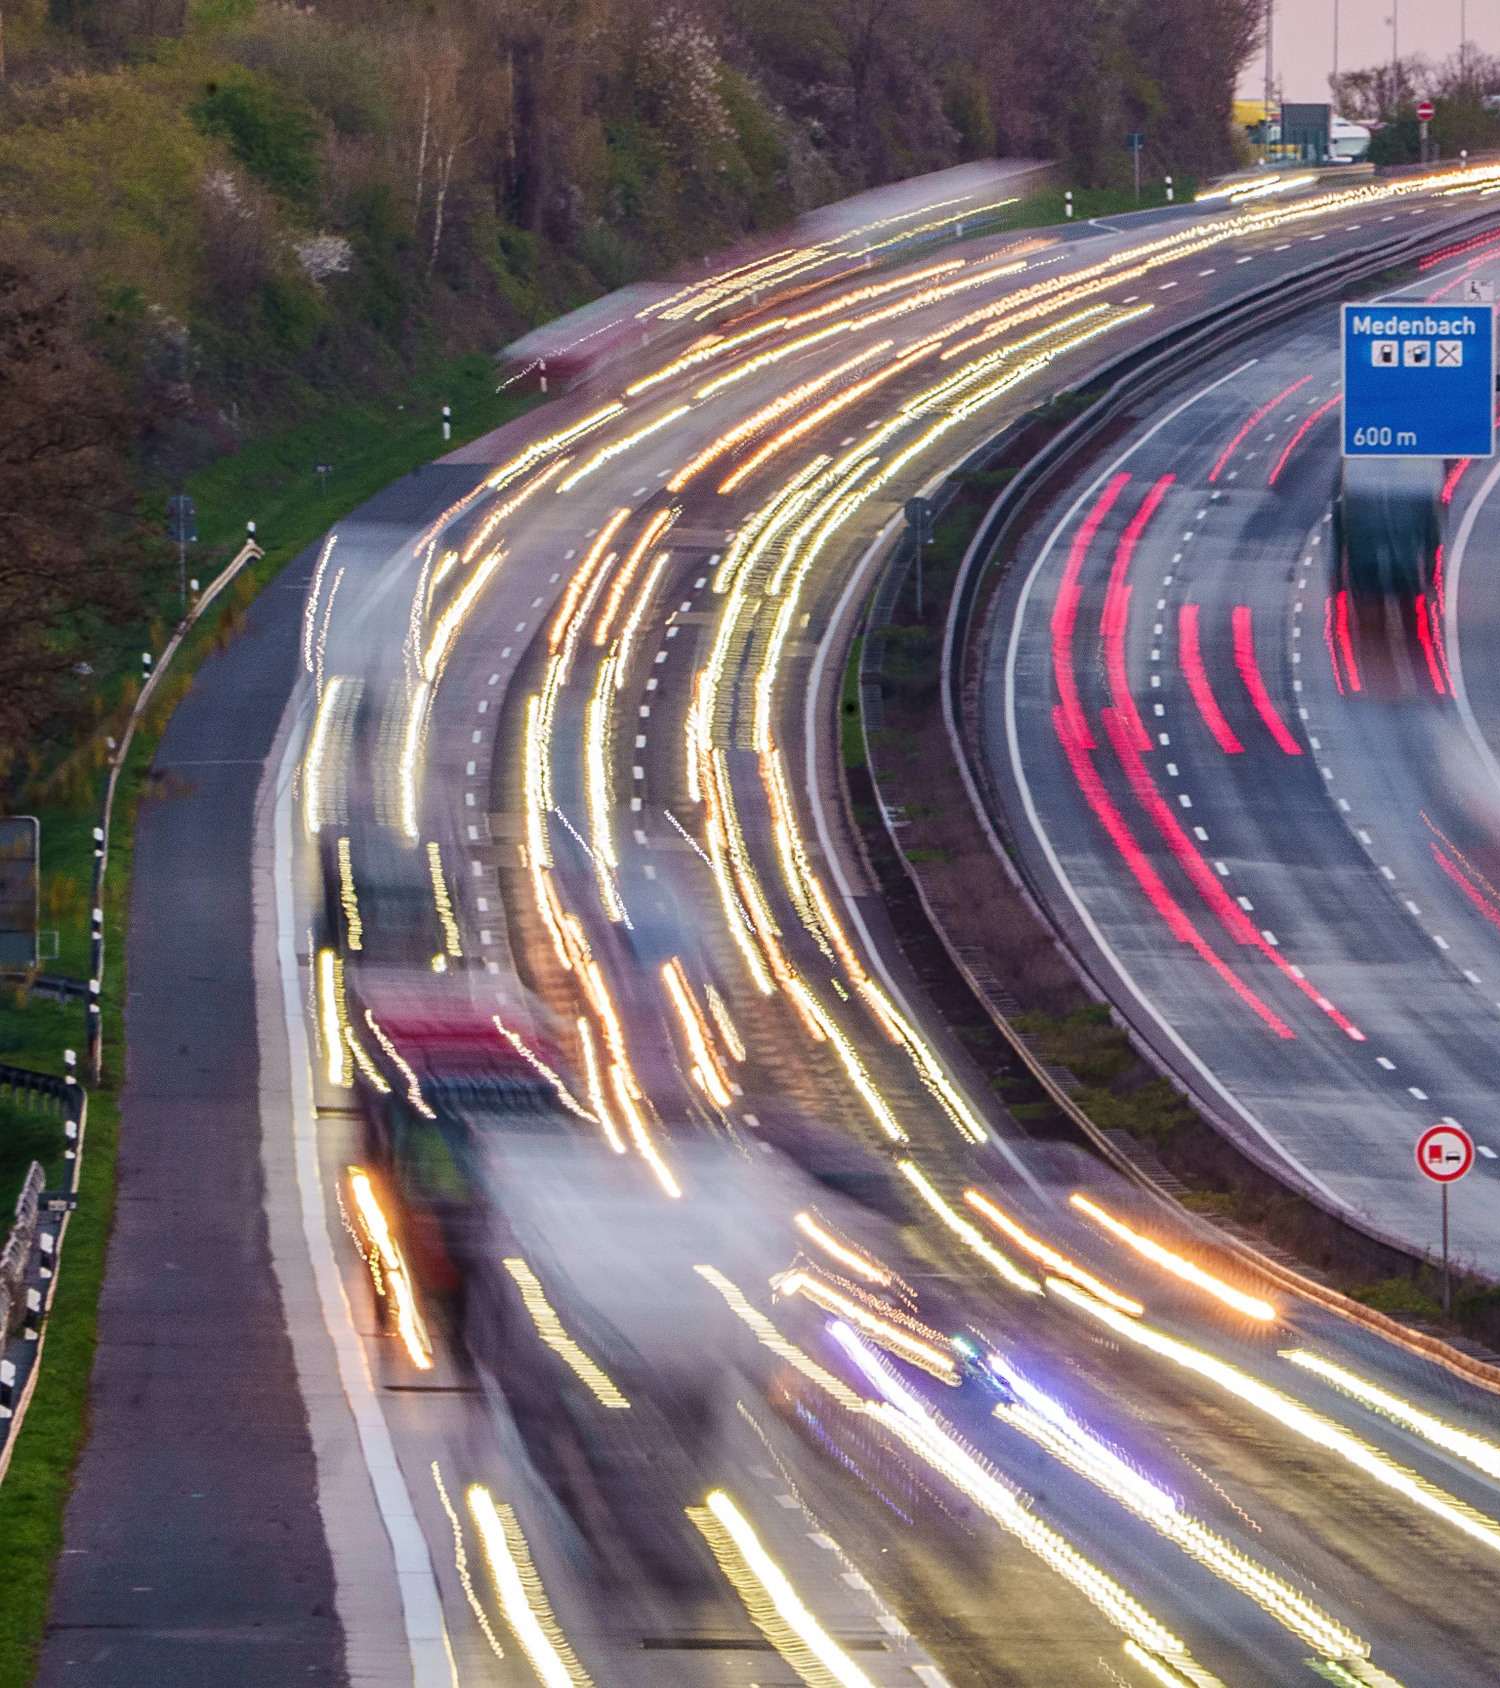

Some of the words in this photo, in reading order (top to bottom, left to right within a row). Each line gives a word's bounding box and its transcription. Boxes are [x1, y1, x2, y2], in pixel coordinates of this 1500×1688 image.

[1353, 315, 1476, 335] Medenbach
[1353, 426, 1392, 446] 600
[1397, 431, 1417, 446] m
